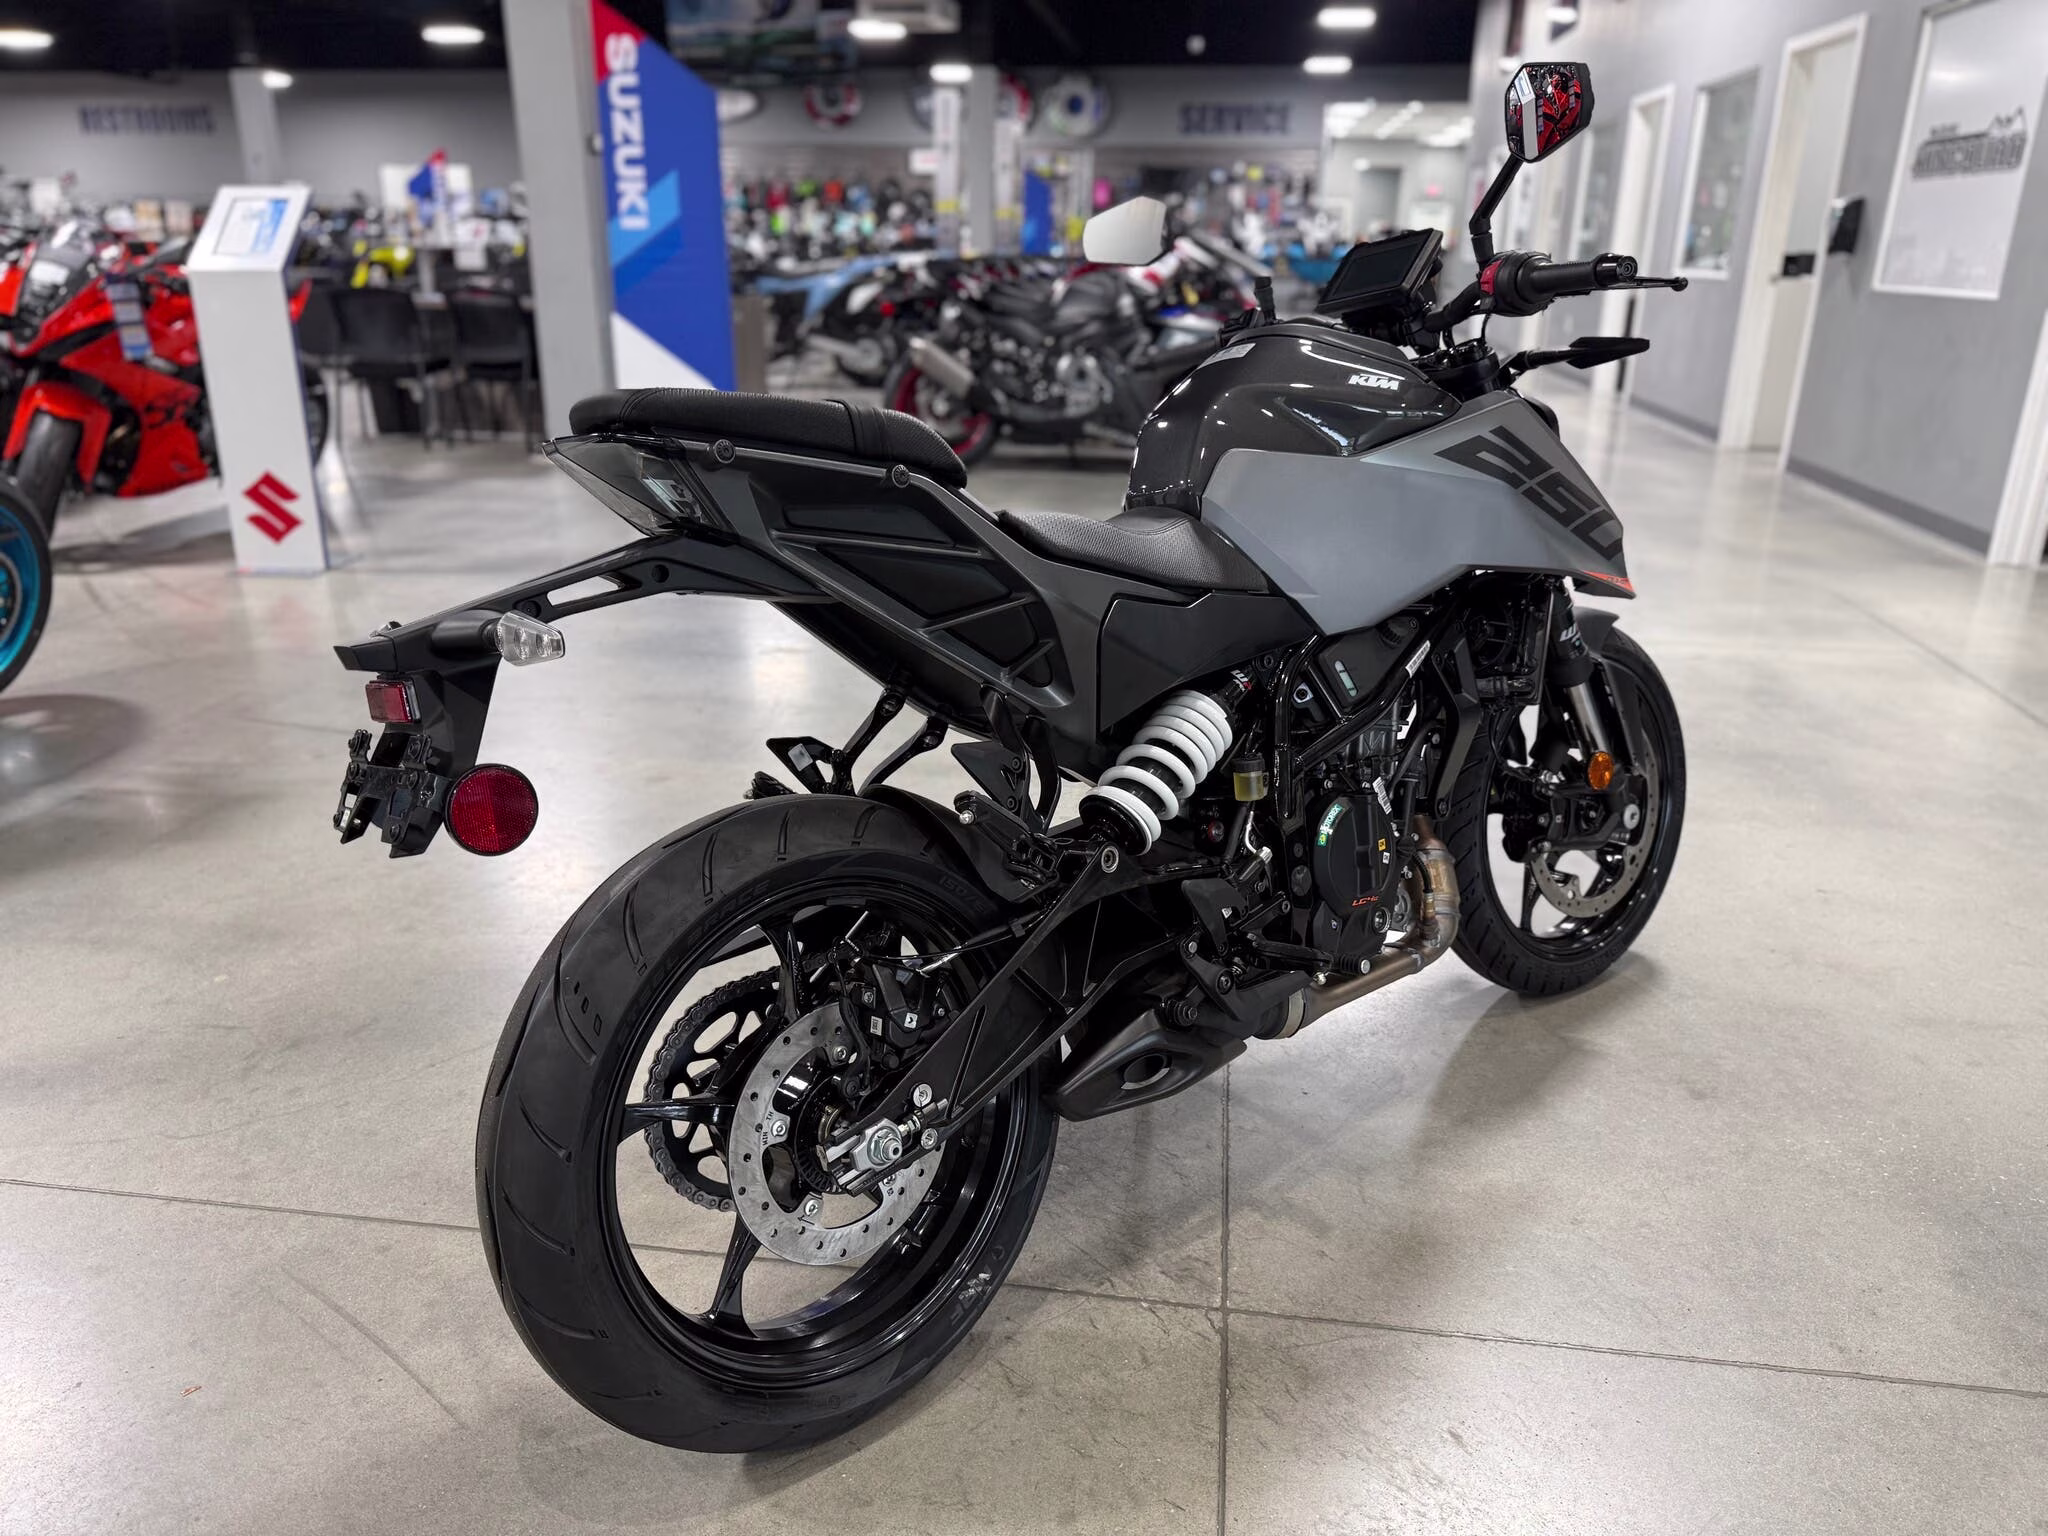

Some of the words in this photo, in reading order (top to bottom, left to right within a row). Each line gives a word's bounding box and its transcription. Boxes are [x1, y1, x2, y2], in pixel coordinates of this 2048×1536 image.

[605, 33, 650, 230] SUZUKI
[1179, 103, 1291, 135] SERVICE
[1348, 373, 1400, 391] KTM
[1433, 425, 1624, 561] 250
[1319, 804, 1343, 835] MOTOREX
